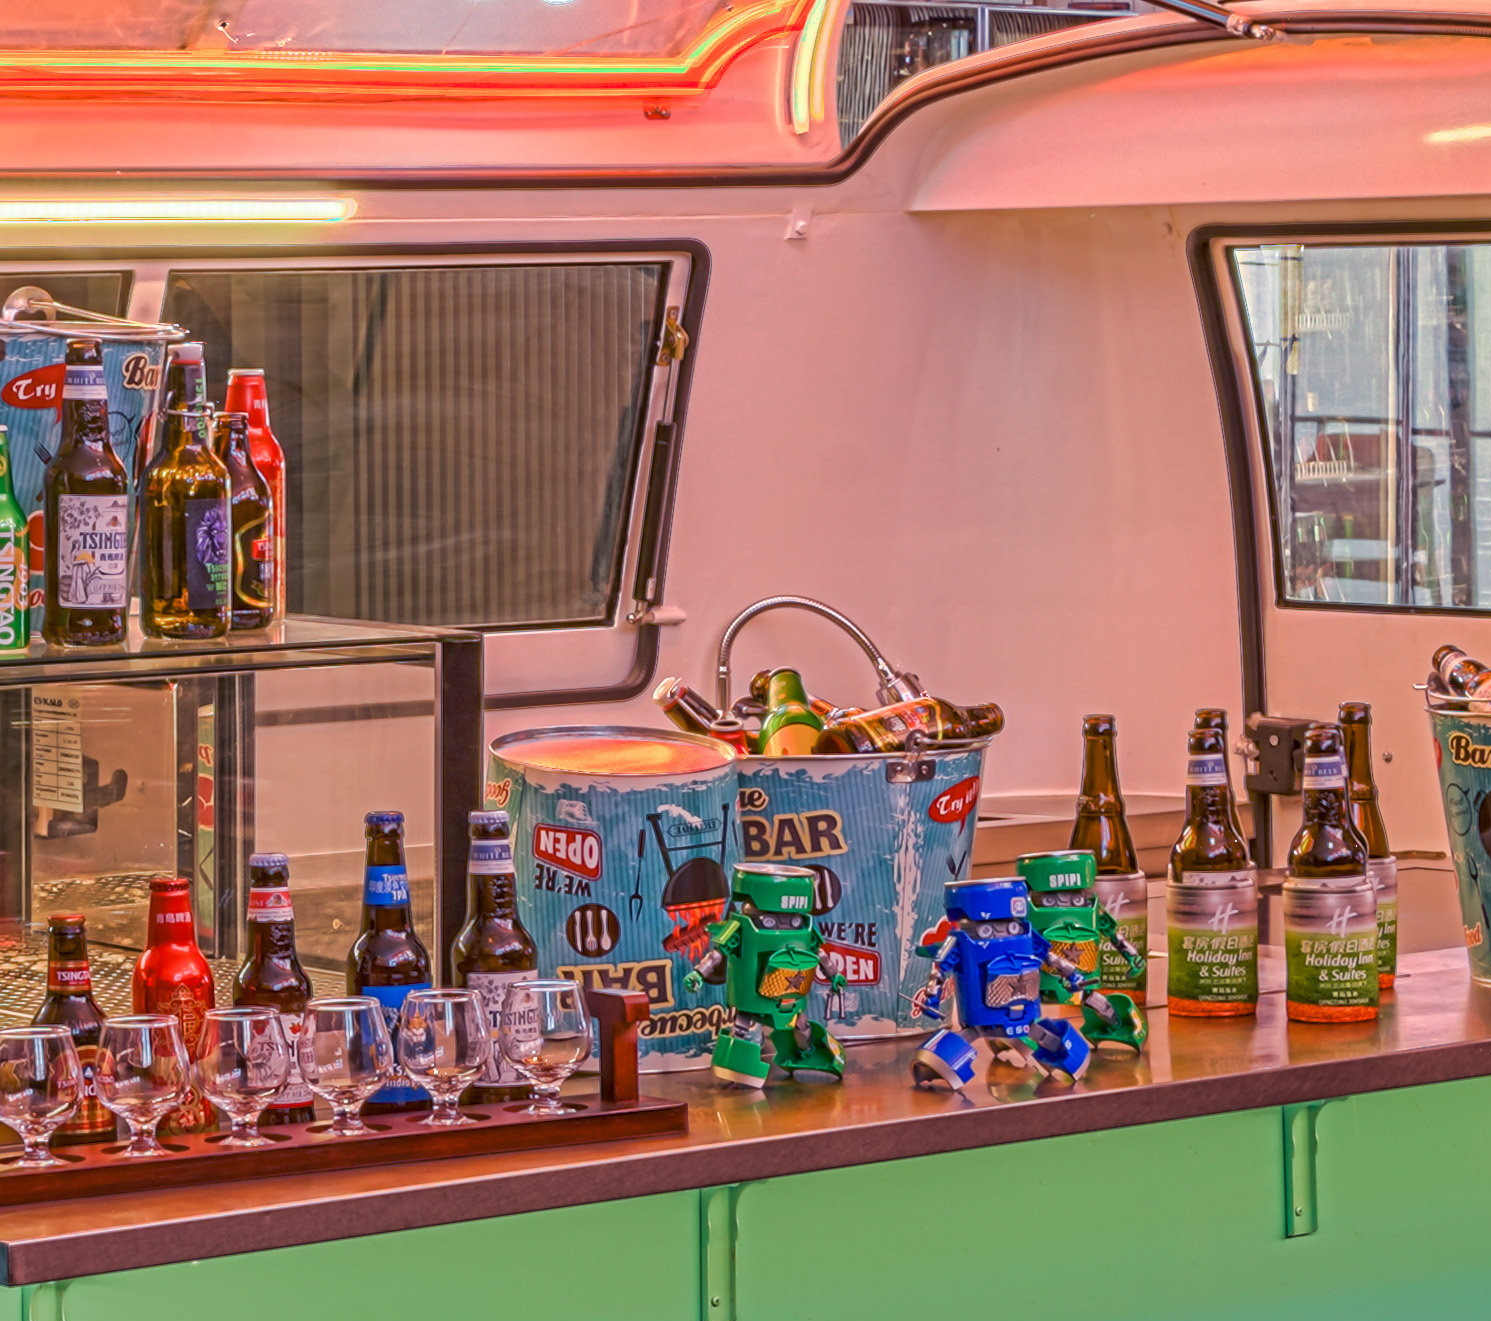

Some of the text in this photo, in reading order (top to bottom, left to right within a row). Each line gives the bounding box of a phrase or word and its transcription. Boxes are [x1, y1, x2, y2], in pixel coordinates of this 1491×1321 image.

[11, 377, 57, 401] Try
[937, 793, 964, 816] Try
[743, 814, 844, 858] BAR
[539, 829, 599, 870] OPEN
[534, 862, 593, 898] WE'RE
[817, 921, 878, 949] WE'RE
[1187, 948, 1253, 965] Holiday Inn
[1305, 952, 1374, 969] Holiday Inn
[1199, 965, 1247, 978] & Suites
[1318, 968, 1367, 981] & Suites
